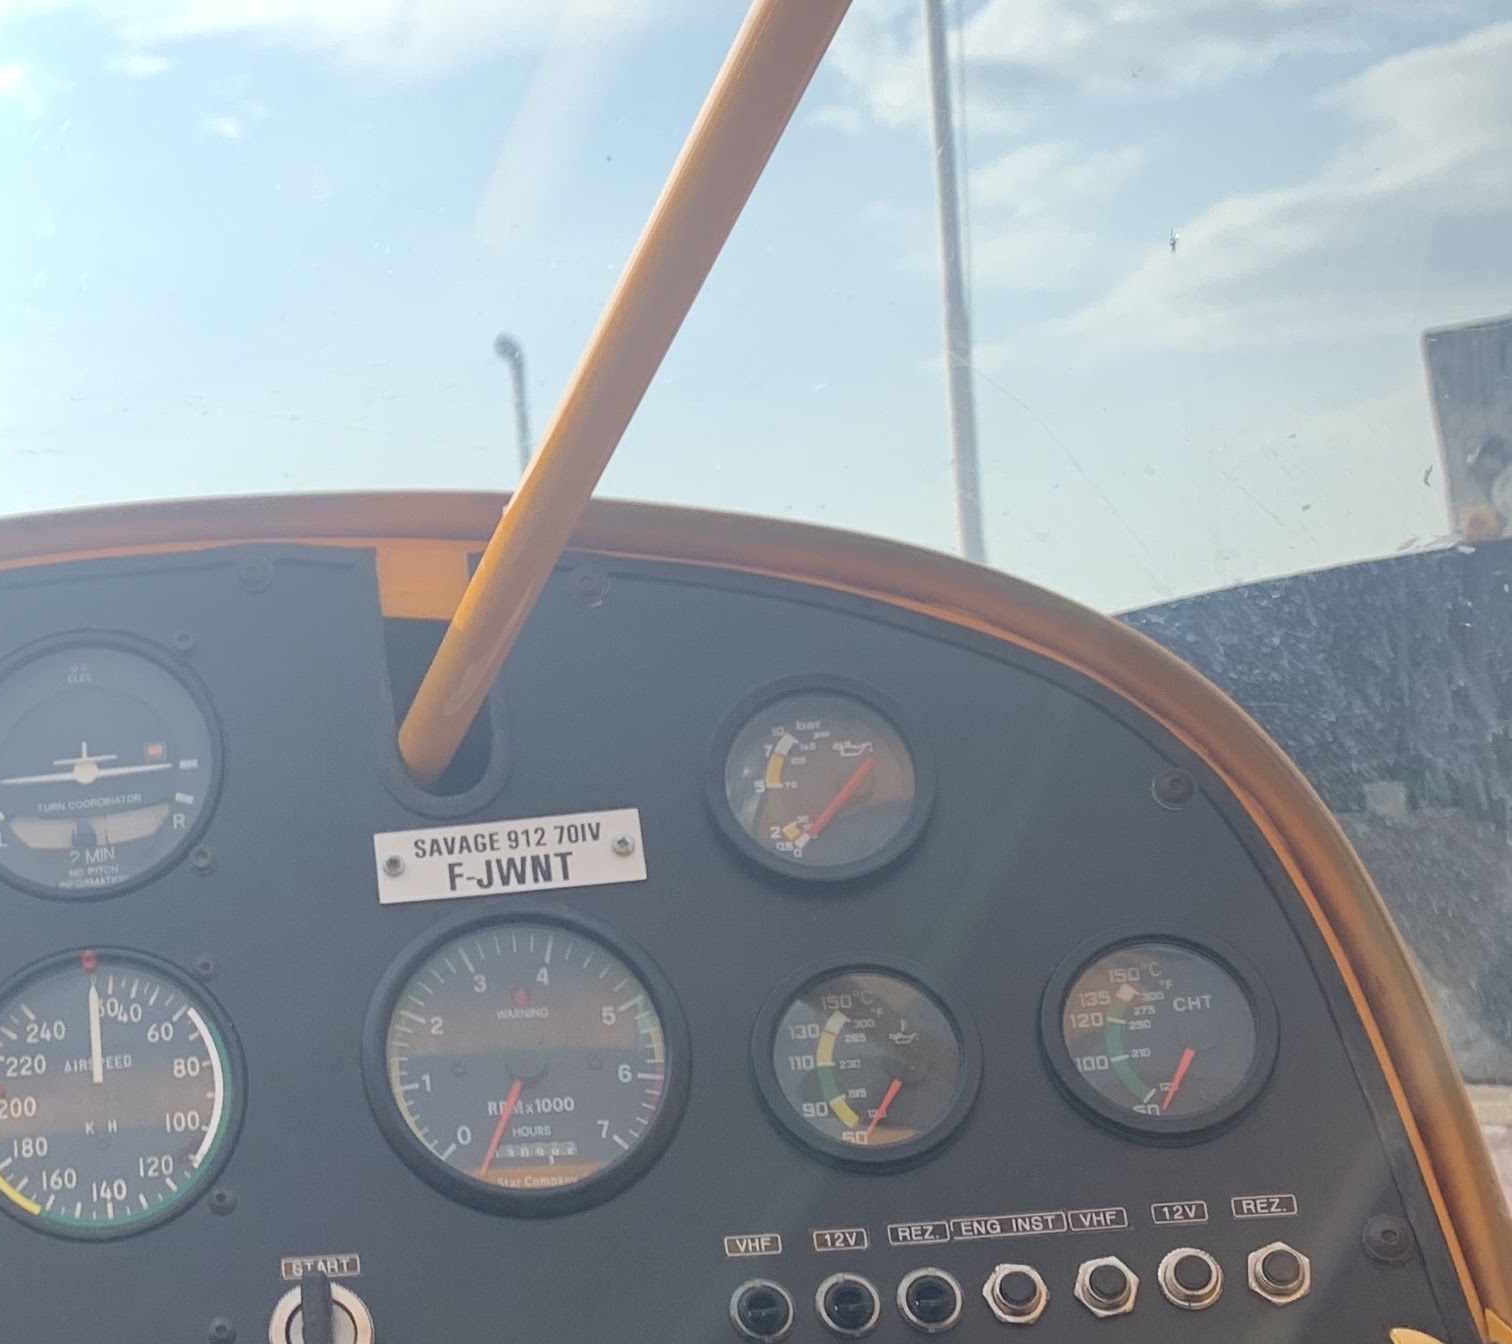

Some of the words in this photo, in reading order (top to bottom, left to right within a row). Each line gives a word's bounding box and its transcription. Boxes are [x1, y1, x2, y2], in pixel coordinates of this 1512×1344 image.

[795, 720, 821, 731] bar
[754, 780, 766, 793] 5
[173, 813, 186, 829] R
[770, 826, 781, 839] 2
[413, 832, 501, 859] SAVAGE
[506, 827, 546, 850] 912
[85, 846, 115, 865] MIN
[447, 851, 574, 892] F-JWNT
[474, 975, 487, 993] 3
[536, 967, 549, 986] 4
[1108, 967, 1140, 983] 150
[821, 994, 852, 1010] 150
[1079, 991, 1112, 1007] 135
[1172, 995, 1212, 1012] CHT
[117, 1004, 142, 1023] 40
[496, 1007, 549, 1020] WARNING
[601, 1007, 617, 1026] 5
[1070, 1012, 1103, 1029] 120
[26, 1020, 66, 1044] 240
[147, 1022, 174, 1043] 60
[430, 1016, 444, 1035] 2
[790, 1023, 820, 1040] 130
[6, 1054, 46, 1077] 220
[173, 1057, 200, 1078] 80
[789, 1056, 815, 1071] 110
[1074, 1055, 1109, 1072] 100
[421, 1073, 431, 1092] 1
[618, 1064, 632, 1083] 6
[802, 1102, 829, 1117] 90
[166, 1111, 200, 1133] 100
[597, 1120, 610, 1138] 7
[457, 1125, 472, 1145] 0
[512, 1125, 551, 1138] HOURS
[13, 1137, 48, 1158] 180
[139, 1155, 173, 1177] 120
[41, 1168, 77, 1191] 160
[92, 1179, 127, 1202] 140
[1162, 1204, 1196, 1219] 12V
[1242, 1198, 1287, 1213] REZ.
[961, 1218, 1001, 1236] ENG
[1012, 1216, 1056, 1233] INST
[1080, 1211, 1117, 1226] VHF
[824, 1231, 858, 1247] 12V
[897, 1225, 941, 1241] REZ.
[736, 1237, 771, 1253] VHF
[292, 1258, 350, 1277] START
